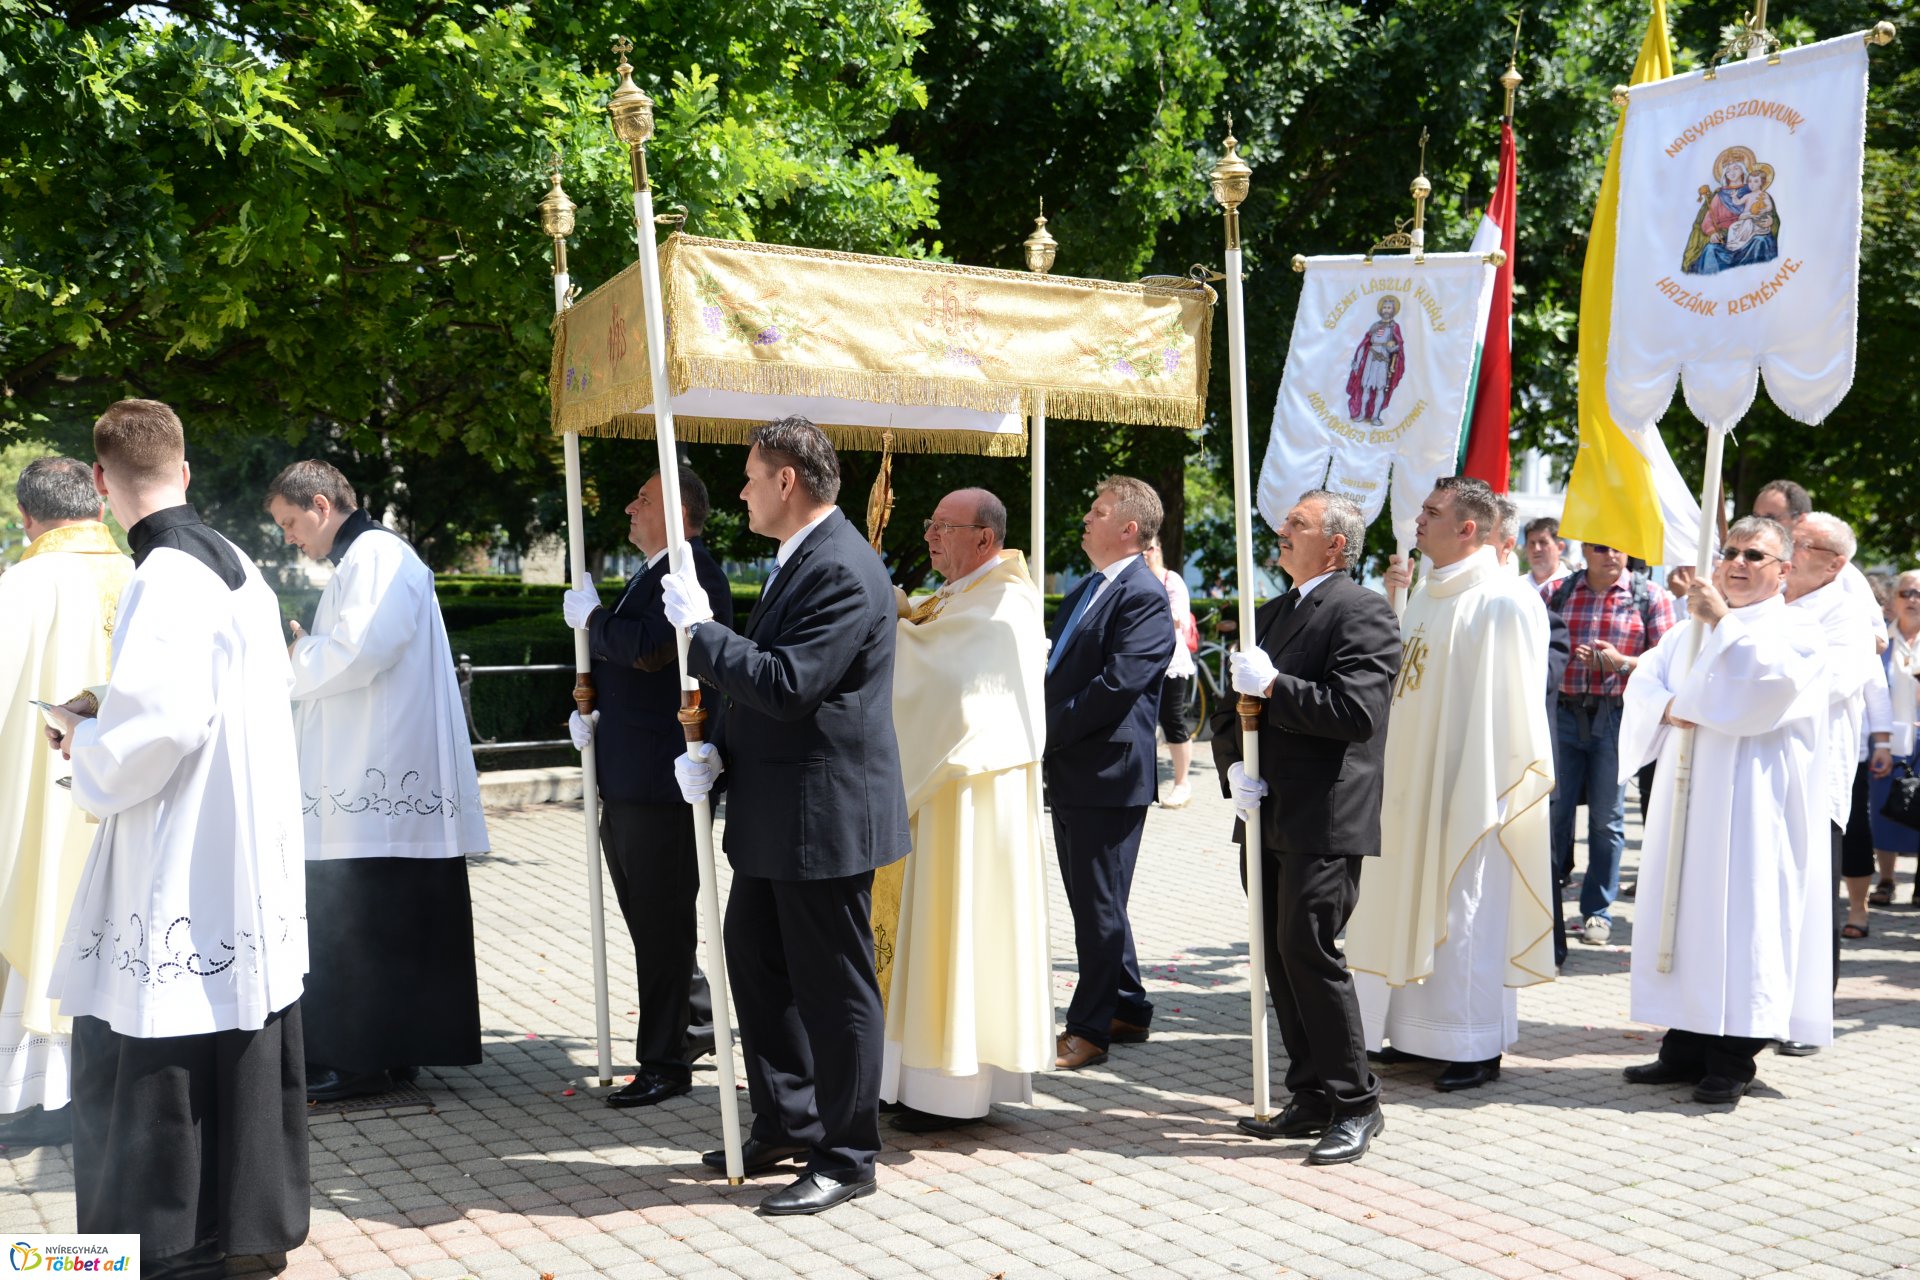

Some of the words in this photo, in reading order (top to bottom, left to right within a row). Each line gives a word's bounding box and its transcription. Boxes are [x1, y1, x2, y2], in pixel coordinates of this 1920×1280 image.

[1324, 289, 1359, 331] SZENT
[1656, 276, 1718, 317] HAZÁNK
[1727, 257, 1804, 316] REMÉNYE.
